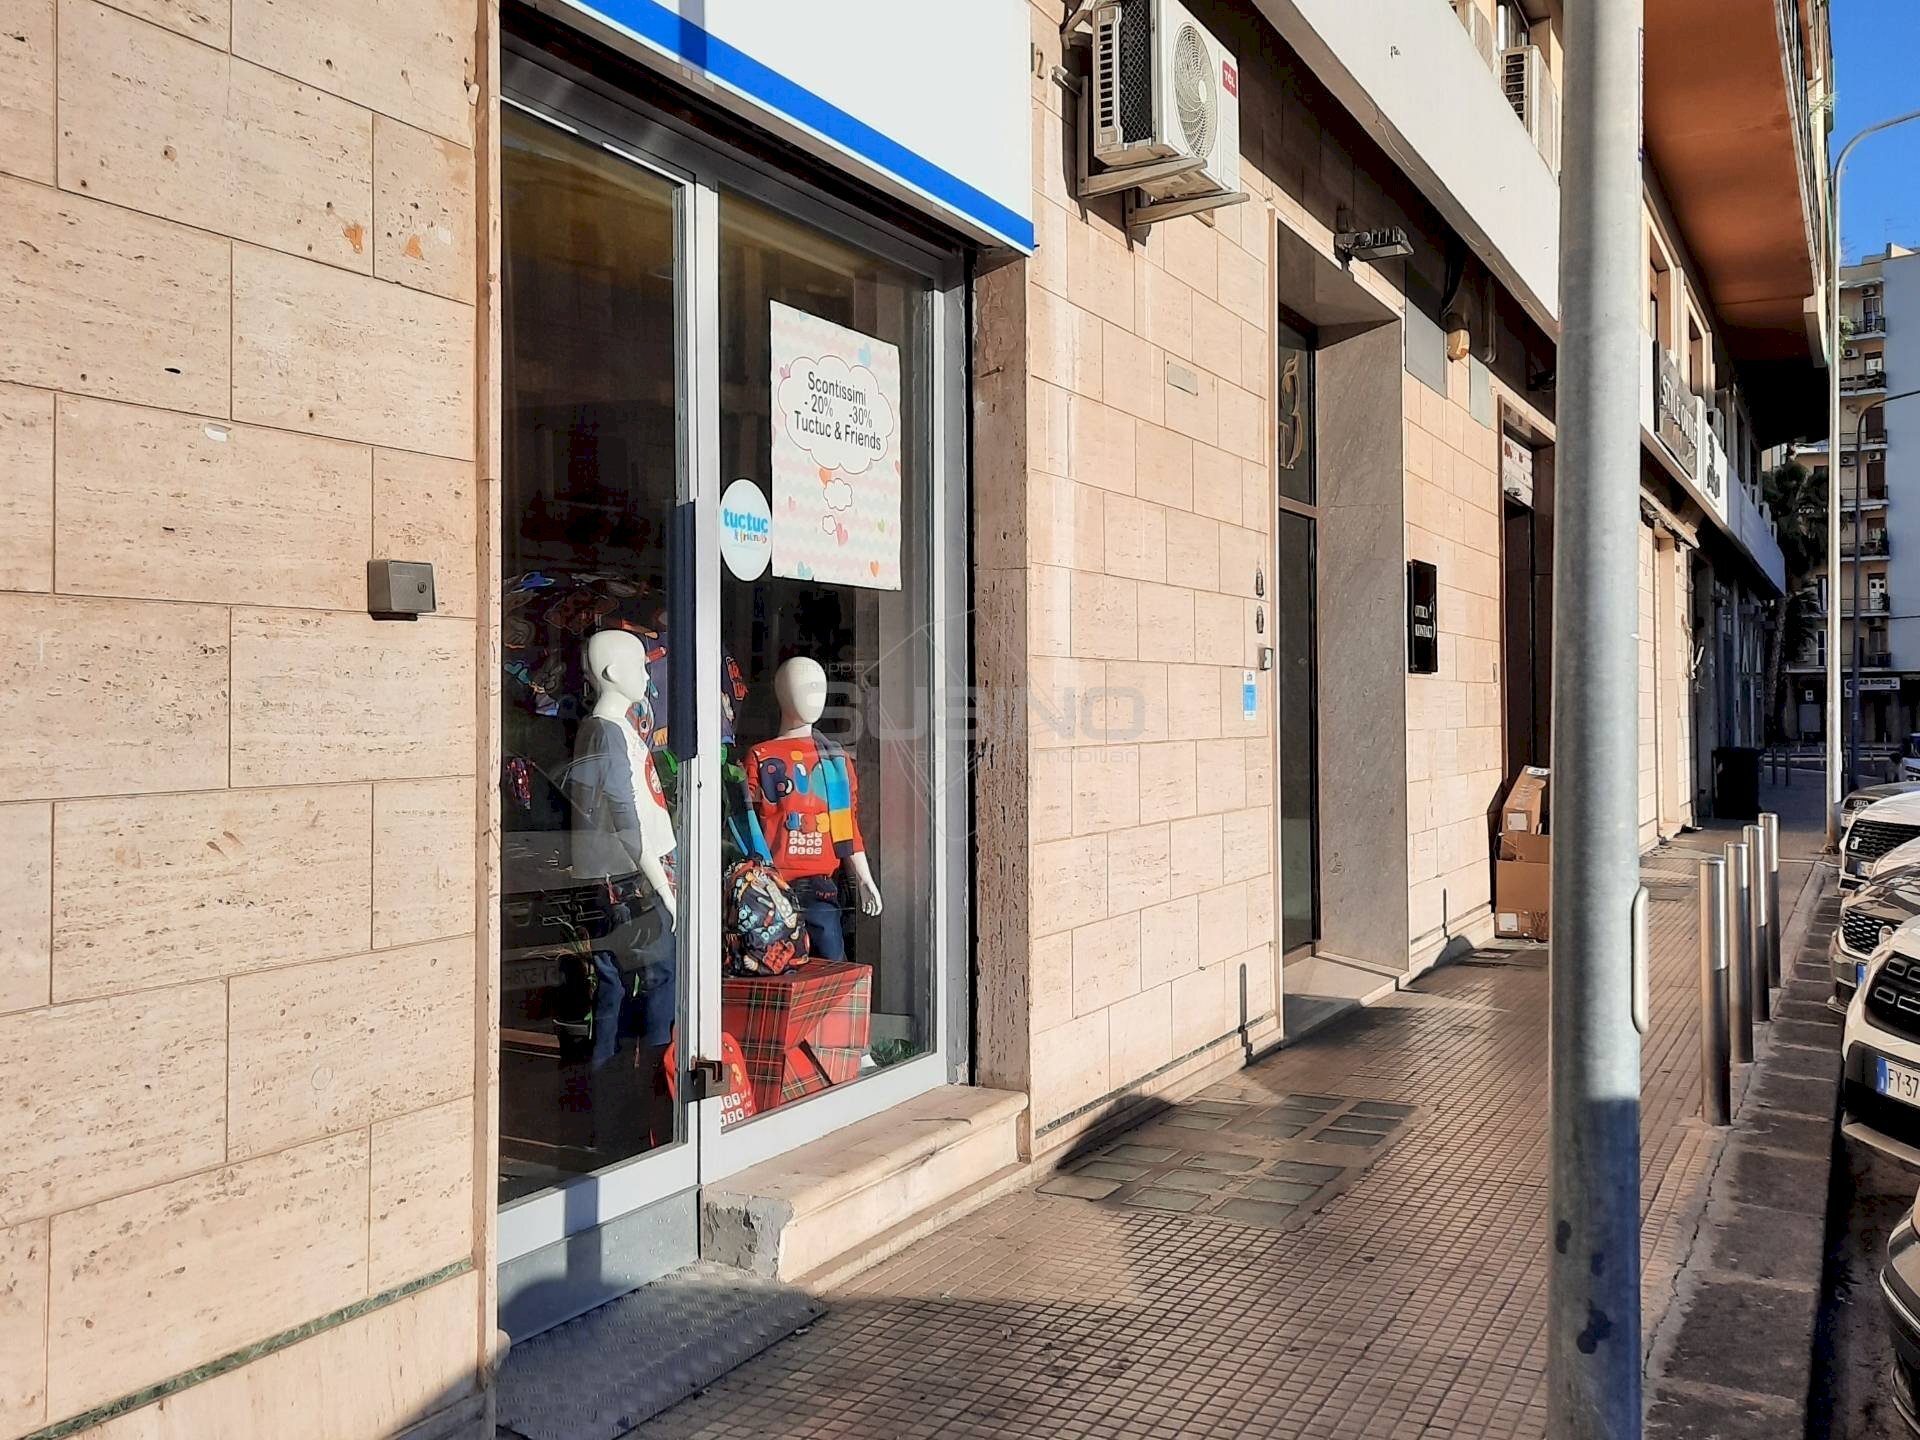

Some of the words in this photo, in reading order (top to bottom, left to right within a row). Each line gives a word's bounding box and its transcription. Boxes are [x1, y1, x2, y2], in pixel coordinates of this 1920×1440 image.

[1223, 70, 1236, 90] TCL
[807, 371, 867, 407] Scontissimi
[811, 396, 834, 418] 20%
[848, 406, 873, 429] -30%
[794, 409, 832, 439] Tuctuc
[834, 422, 842, 440] &
[844, 423, 882, 451] Friends
[723, 507, 769, 534] tuctuc
